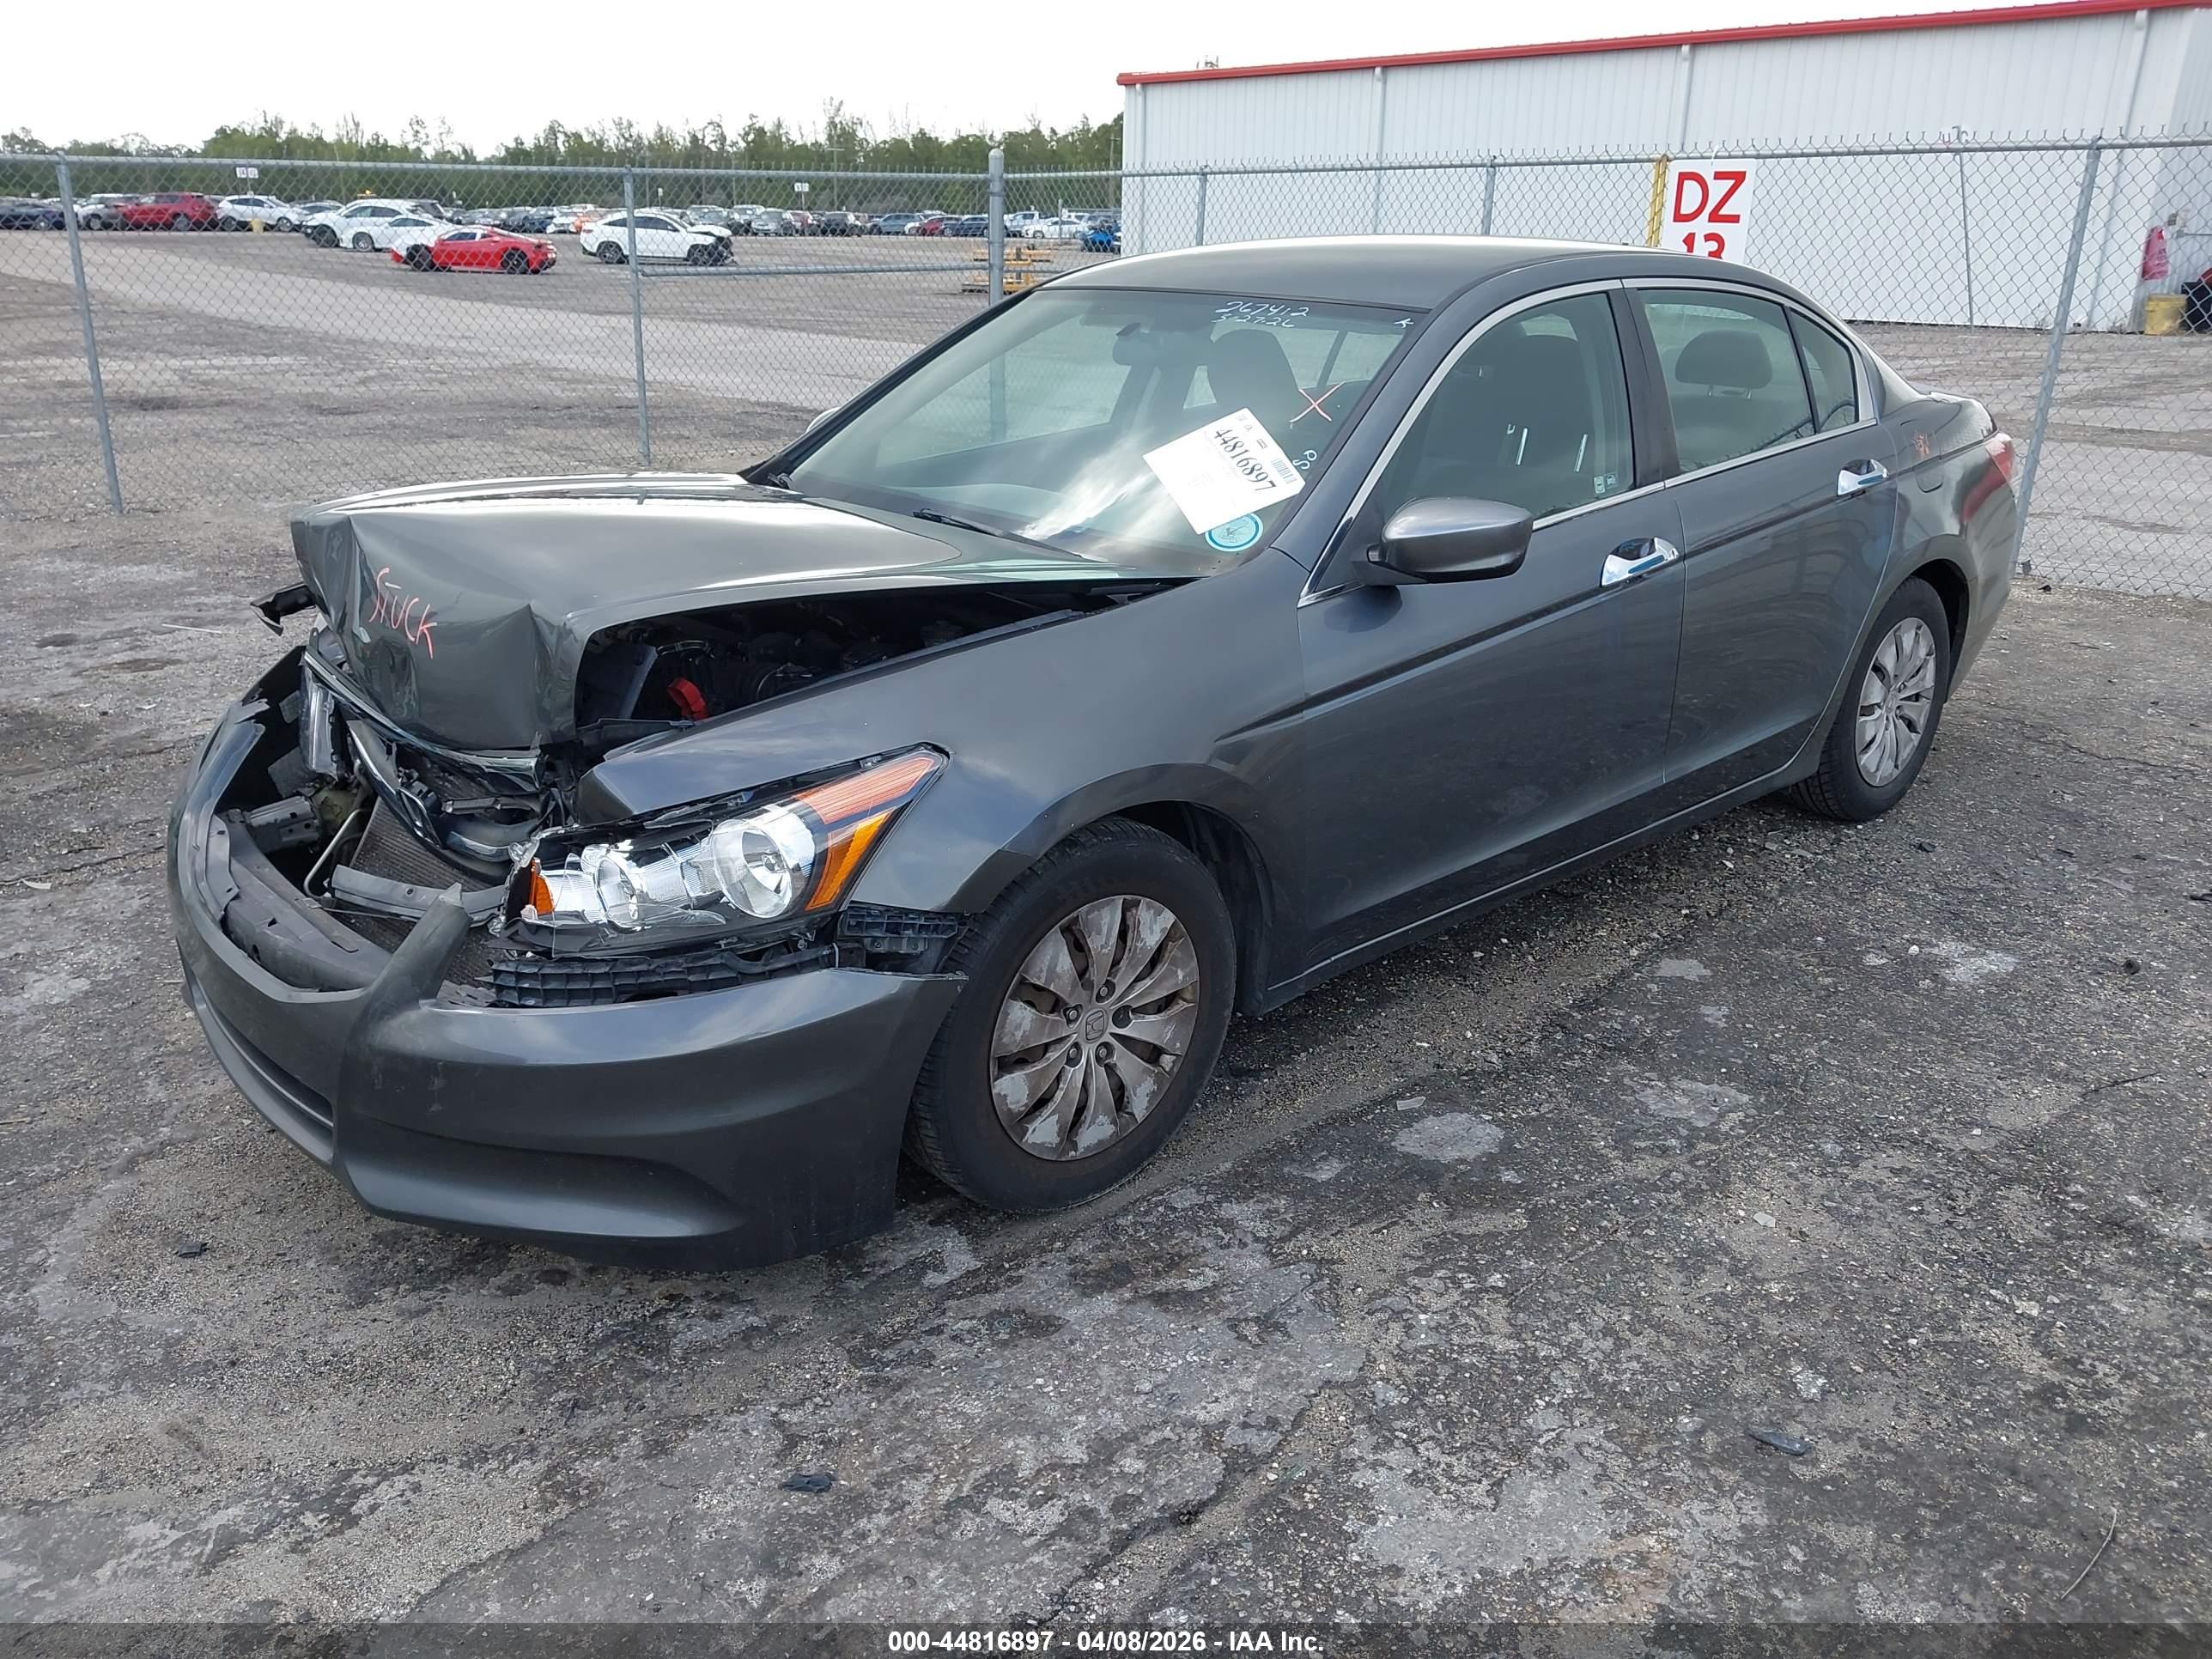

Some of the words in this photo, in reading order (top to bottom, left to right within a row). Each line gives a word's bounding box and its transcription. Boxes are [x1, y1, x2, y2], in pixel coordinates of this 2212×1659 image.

[1673, 171, 1747, 223] DZ
[1213, 428, 1278, 491] 44816897
[368, 567, 439, 659] STUCK
